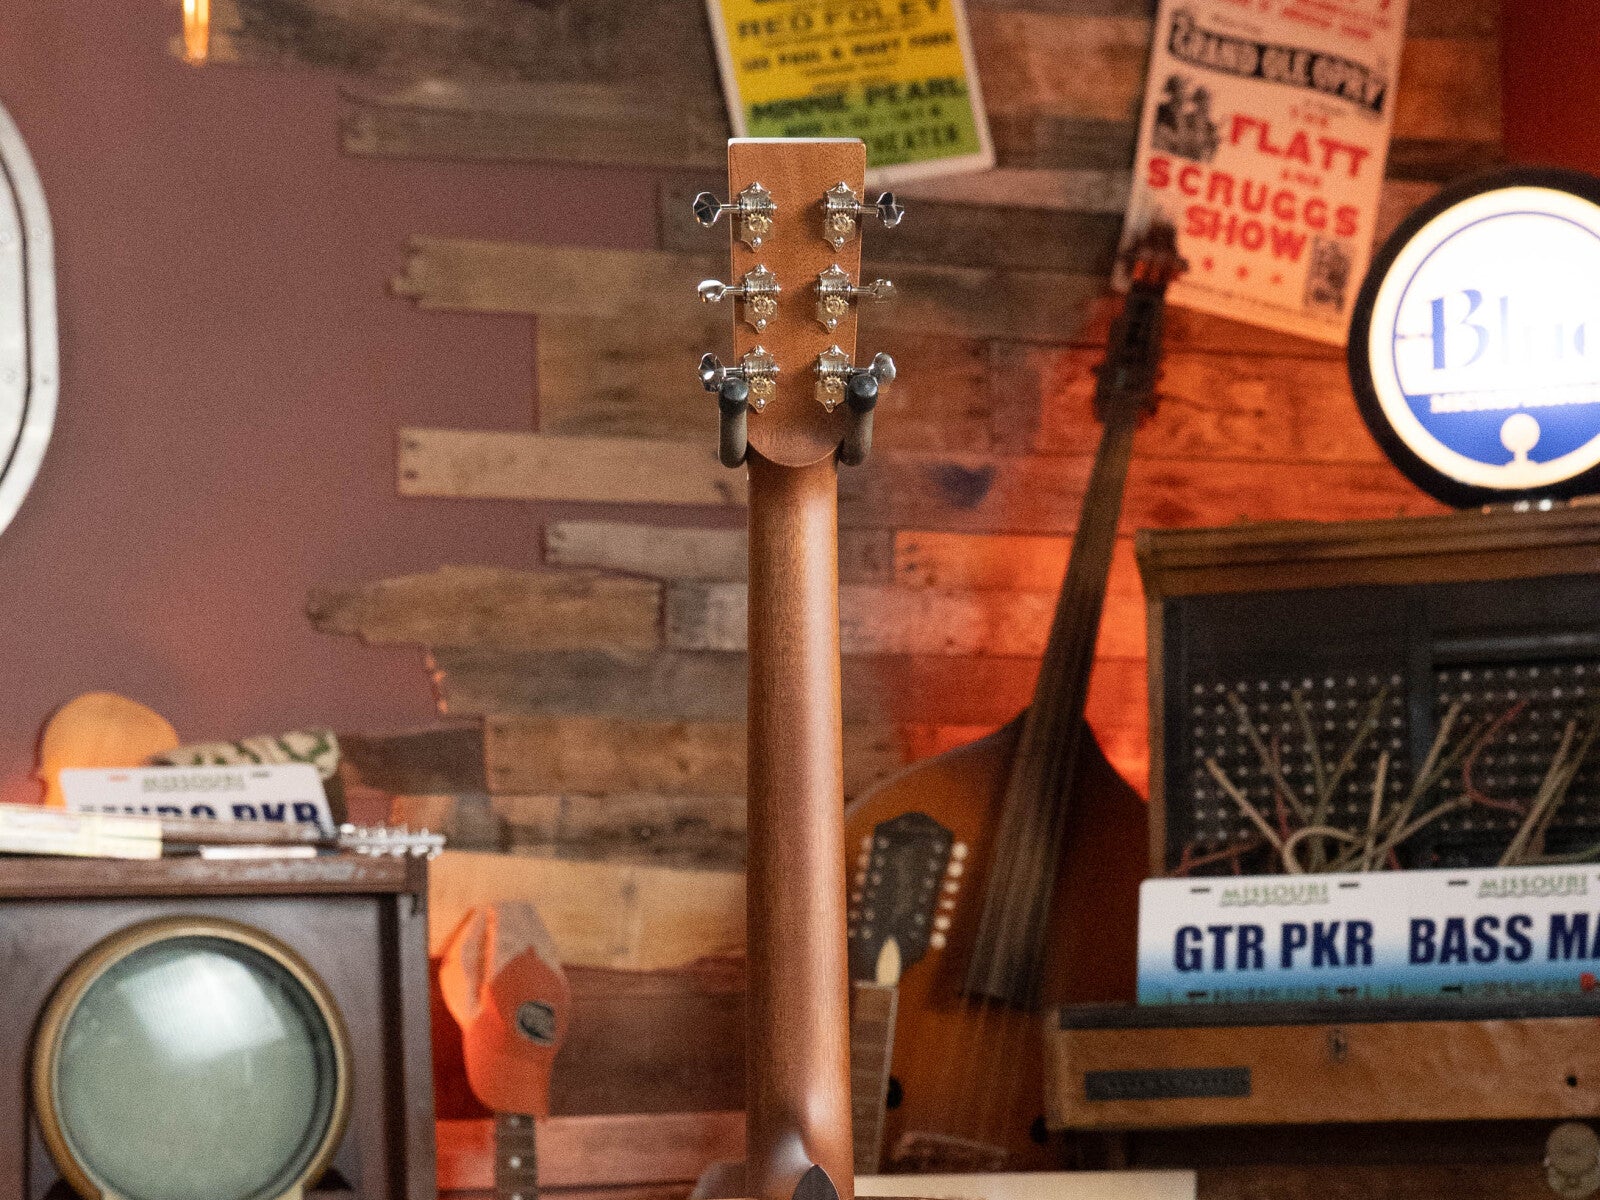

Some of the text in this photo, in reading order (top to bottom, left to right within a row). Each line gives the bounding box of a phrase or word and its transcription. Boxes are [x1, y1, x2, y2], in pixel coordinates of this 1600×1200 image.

[1230, 112, 1371, 179] FLATT
[1147, 157, 1360, 238] SCRUGGS
[1185, 205, 1307, 263] SHOW
[1220, 882, 1330, 905] MISSOURI
[1478, 874, 1589, 897] MISSOURI
[1174, 920, 1374, 972] GTR PKR
[1408, 912, 1600, 965] BASS M
